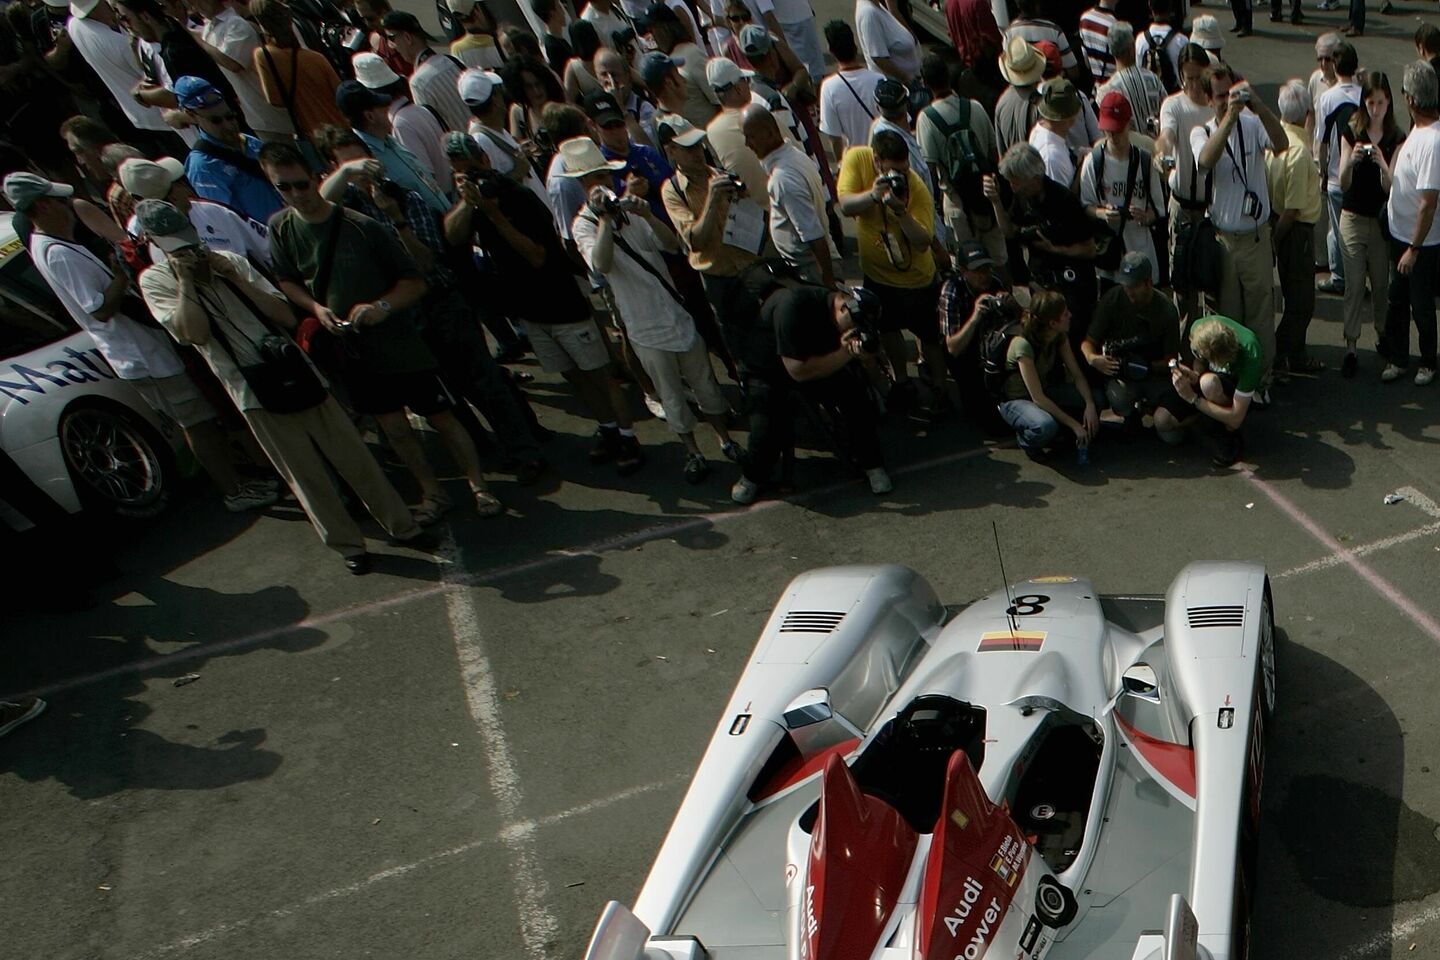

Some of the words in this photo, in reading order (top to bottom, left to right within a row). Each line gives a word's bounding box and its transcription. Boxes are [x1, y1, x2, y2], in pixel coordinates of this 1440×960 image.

[1006, 594, 1050, 615] 8
[806, 884, 818, 939] Audi
[944, 876, 984, 938] Audi
